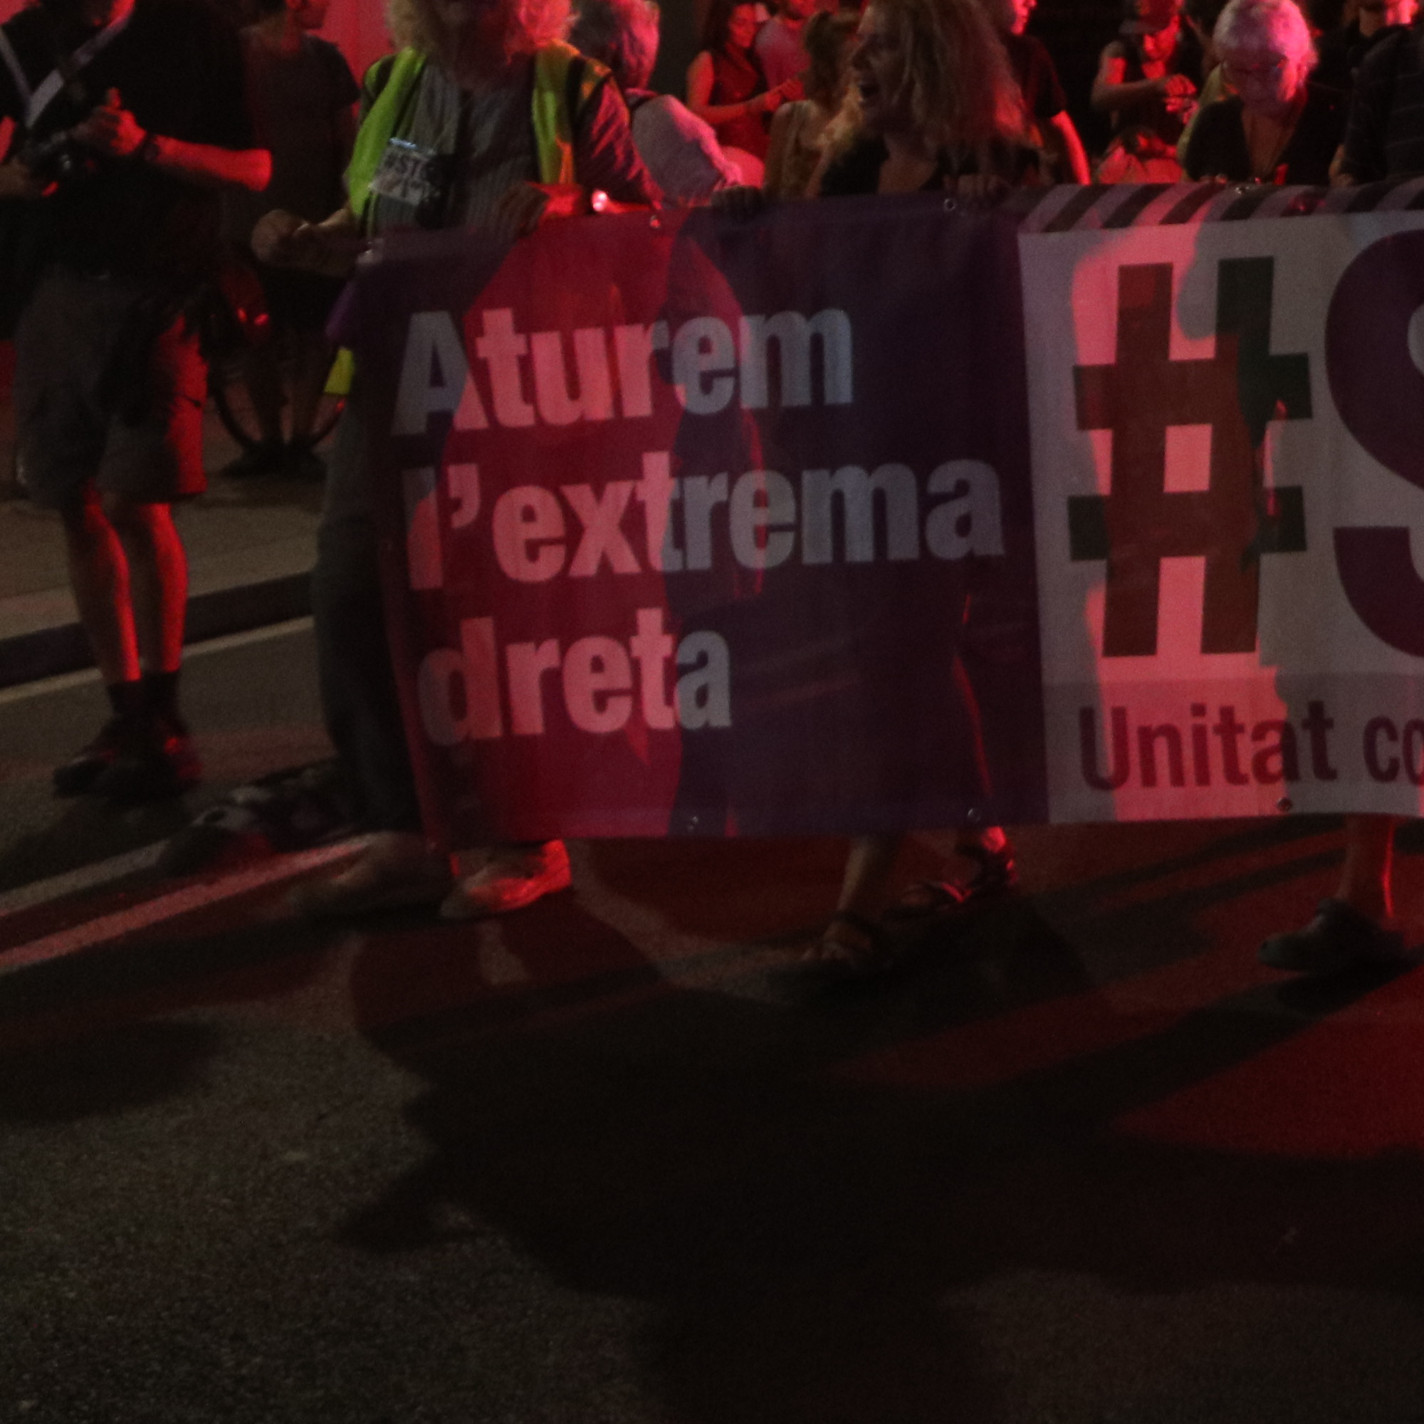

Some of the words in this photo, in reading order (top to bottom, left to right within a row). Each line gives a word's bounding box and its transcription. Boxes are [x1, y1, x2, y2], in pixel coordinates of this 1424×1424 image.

[390, 306, 854, 436] Aturem
[417, 607, 734, 746] dreta
[1078, 701, 1336, 791] Unitat
